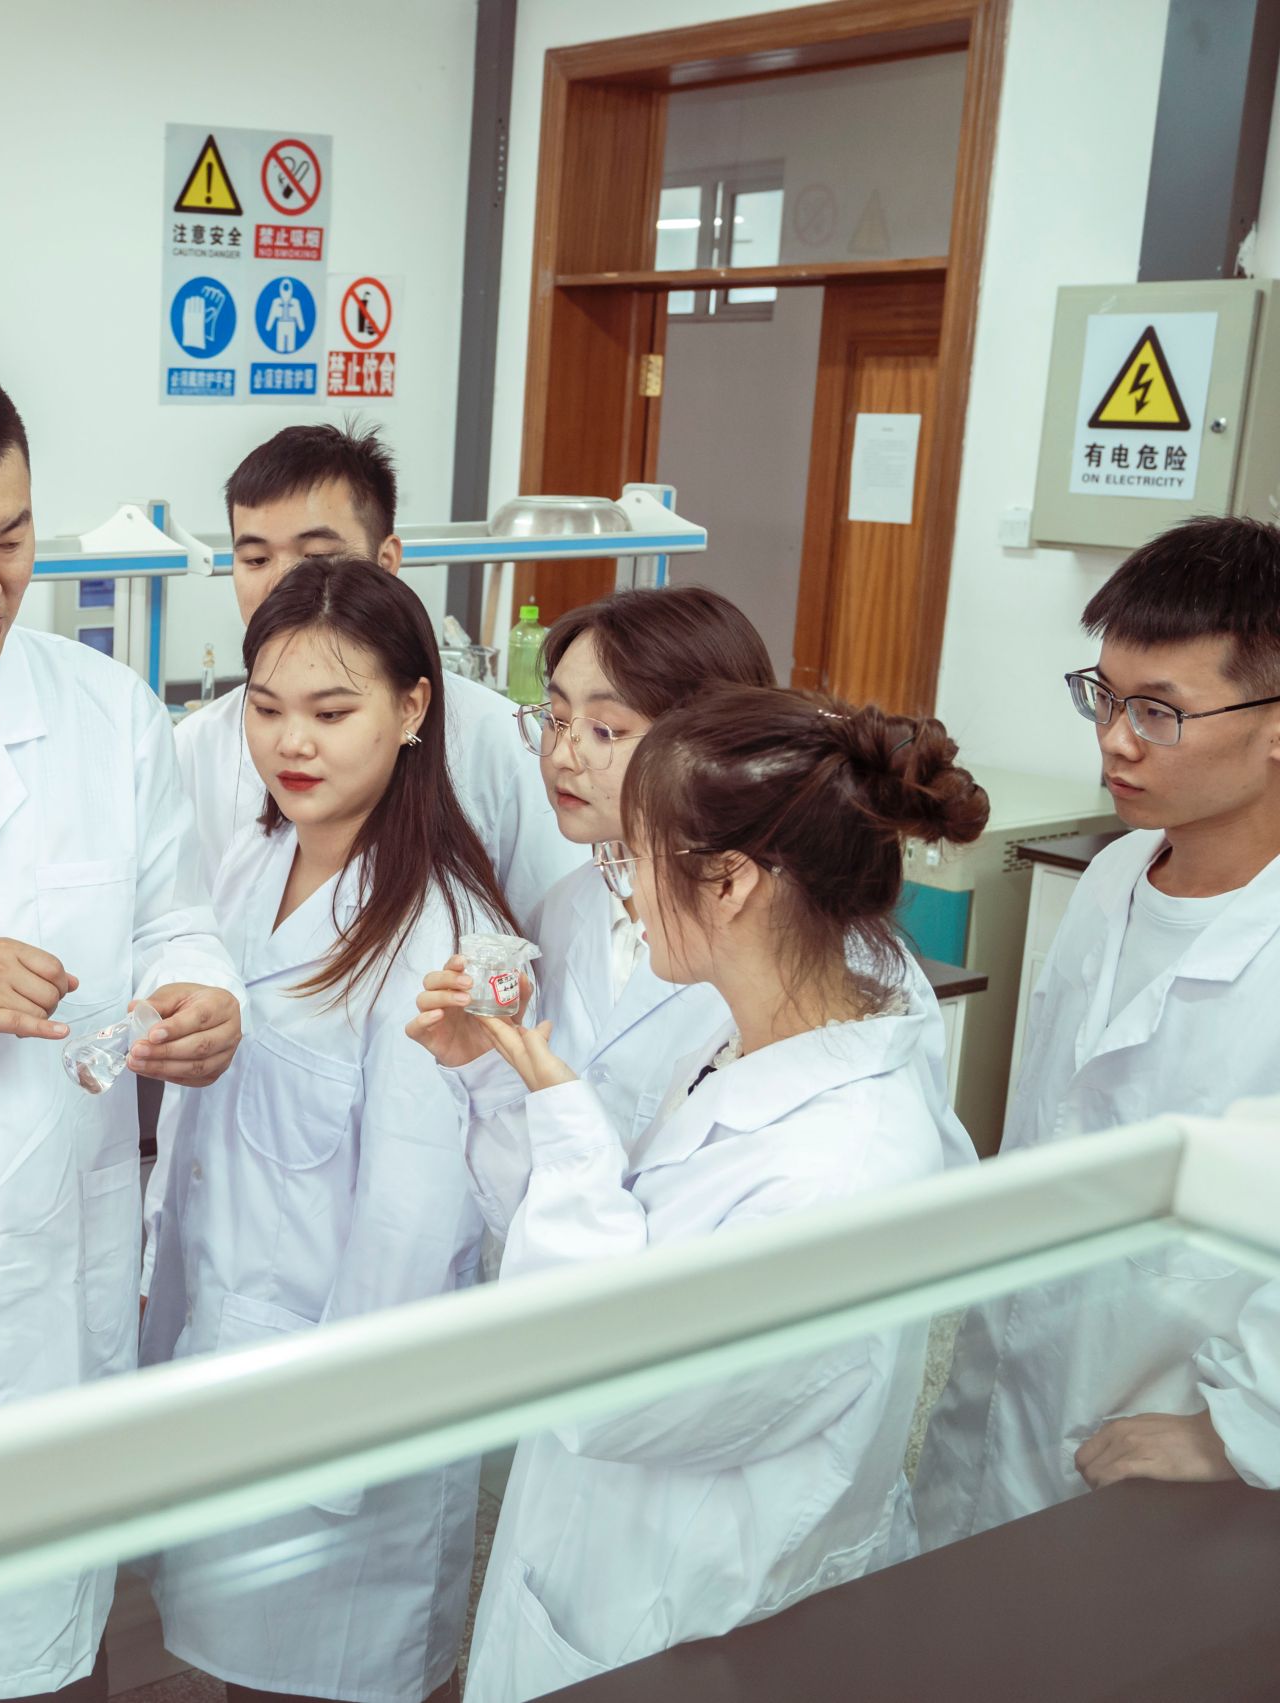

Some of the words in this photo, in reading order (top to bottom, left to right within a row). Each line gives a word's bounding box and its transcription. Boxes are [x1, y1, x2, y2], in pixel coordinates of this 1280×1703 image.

[172, 223, 242, 246] 注意安全
[259, 227, 320, 248] 禁止吸烟
[173, 248, 206, 257] CAUTION
[208, 249, 241, 259] DANGER
[258, 248, 273, 257] NO
[274, 249, 318, 260] SMOKING
[329, 352, 395, 394] 禁止饮食
[1084, 443, 1188, 471] 有电危险
[1081, 473, 1099, 483] ON
[1105, 474, 1185, 487] ELECTRICITY
